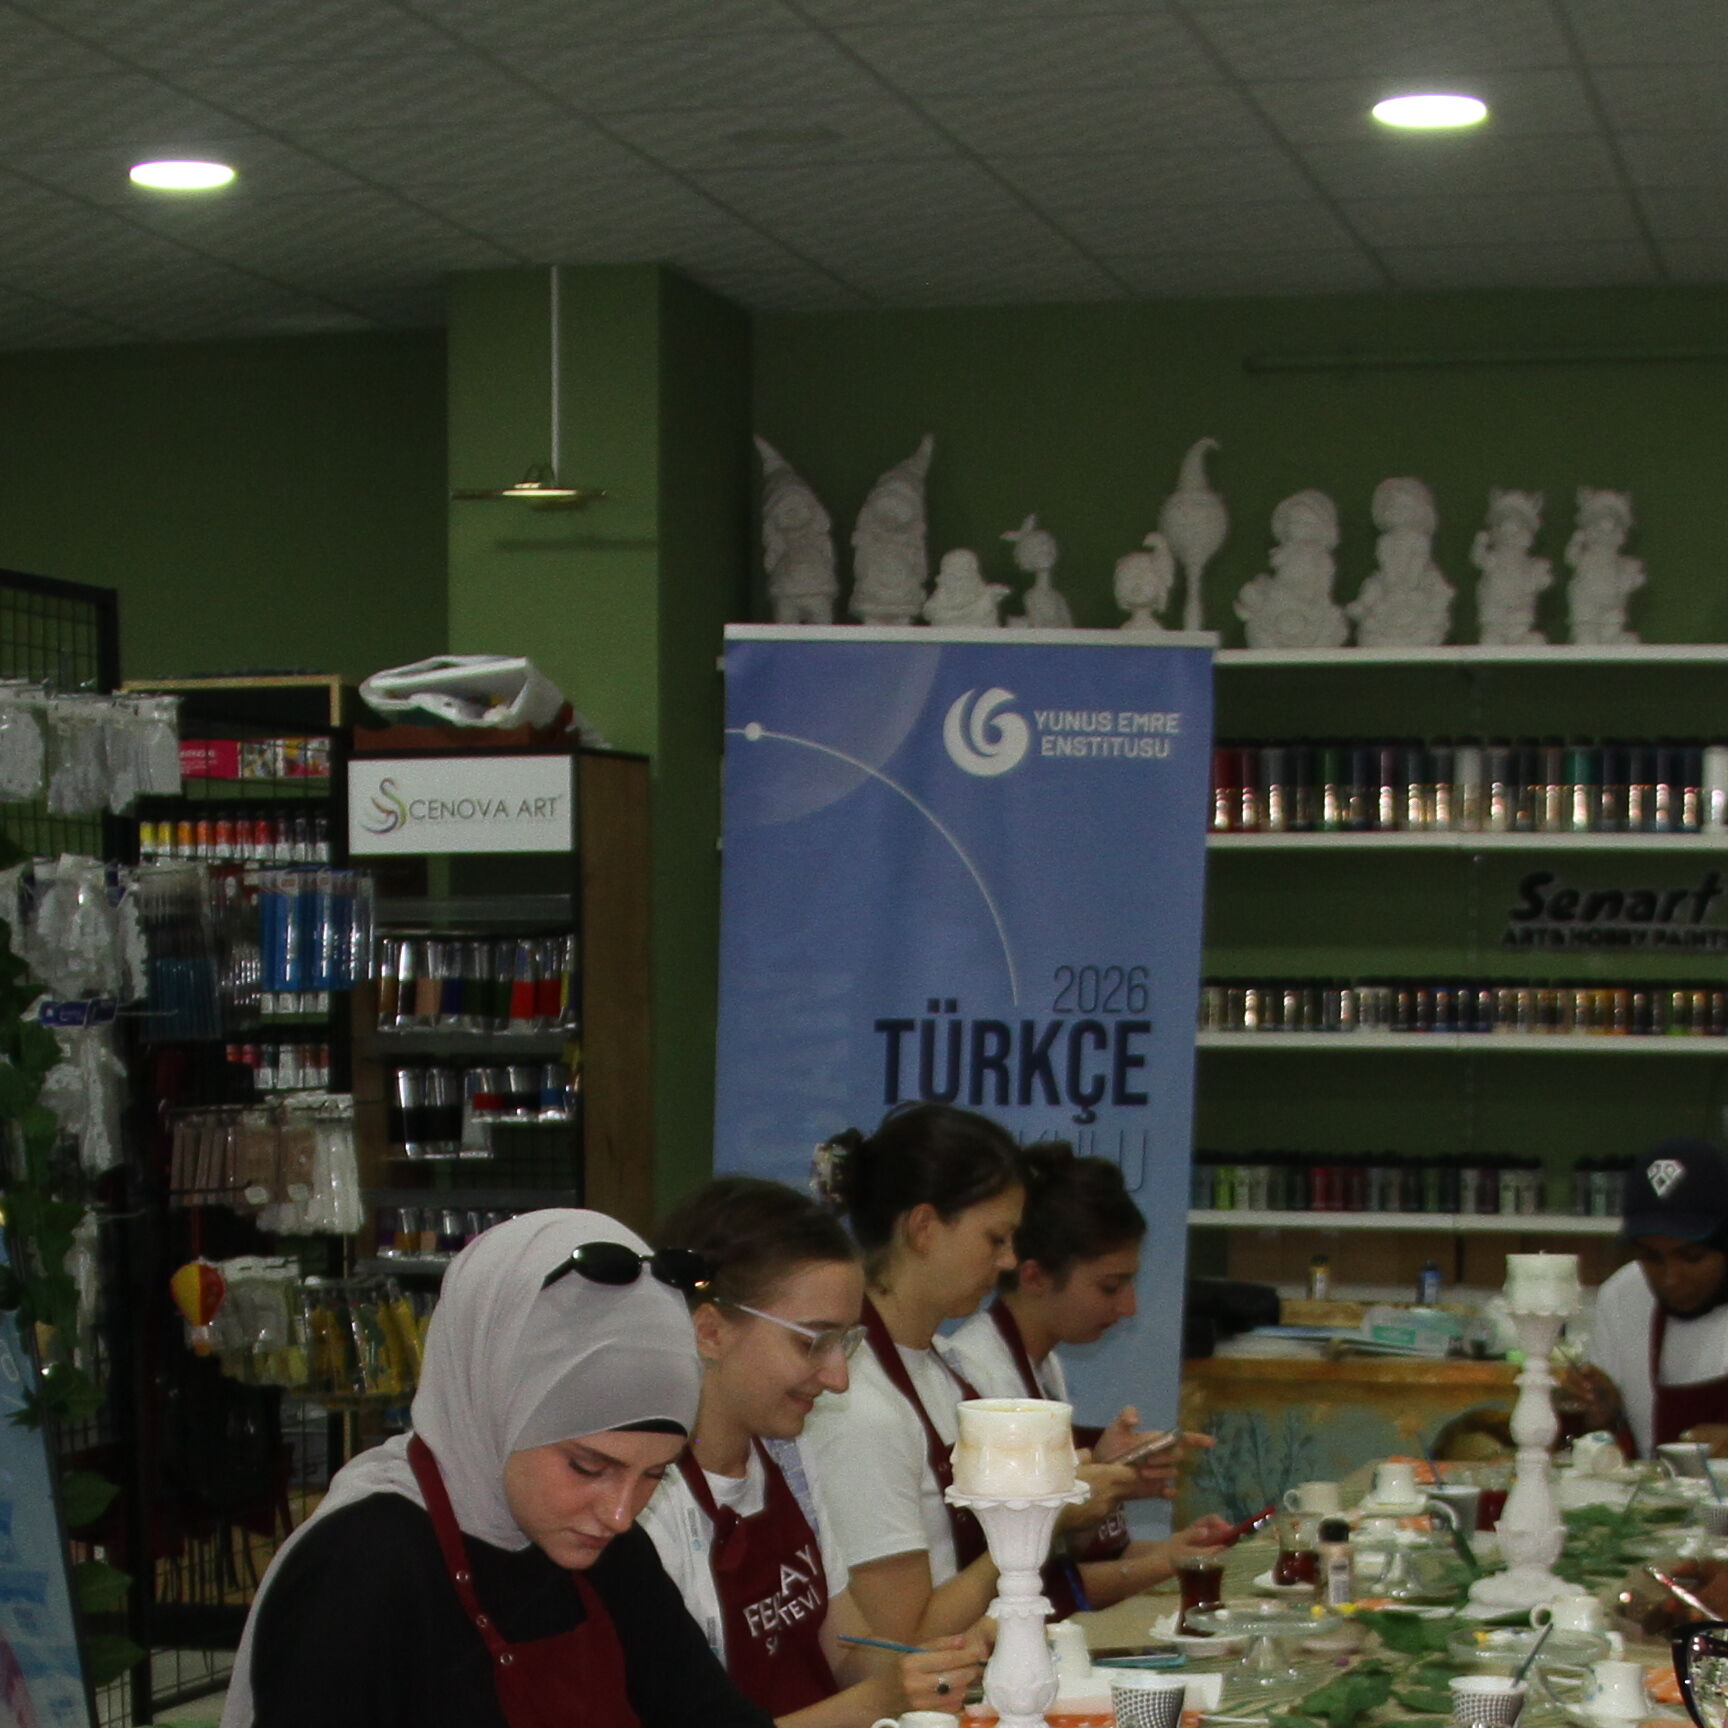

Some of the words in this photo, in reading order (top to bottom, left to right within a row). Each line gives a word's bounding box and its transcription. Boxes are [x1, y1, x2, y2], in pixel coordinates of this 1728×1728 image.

[1033, 710, 1113, 731] YUNUS
[1117, 712, 1181, 733] EMRE
[517, 797, 559, 817] ART
[1508, 871, 1722, 923] Senart
[1053, 966, 1149, 1013] 2026
[874, 998, 1152, 1124] TÜRKÇE
